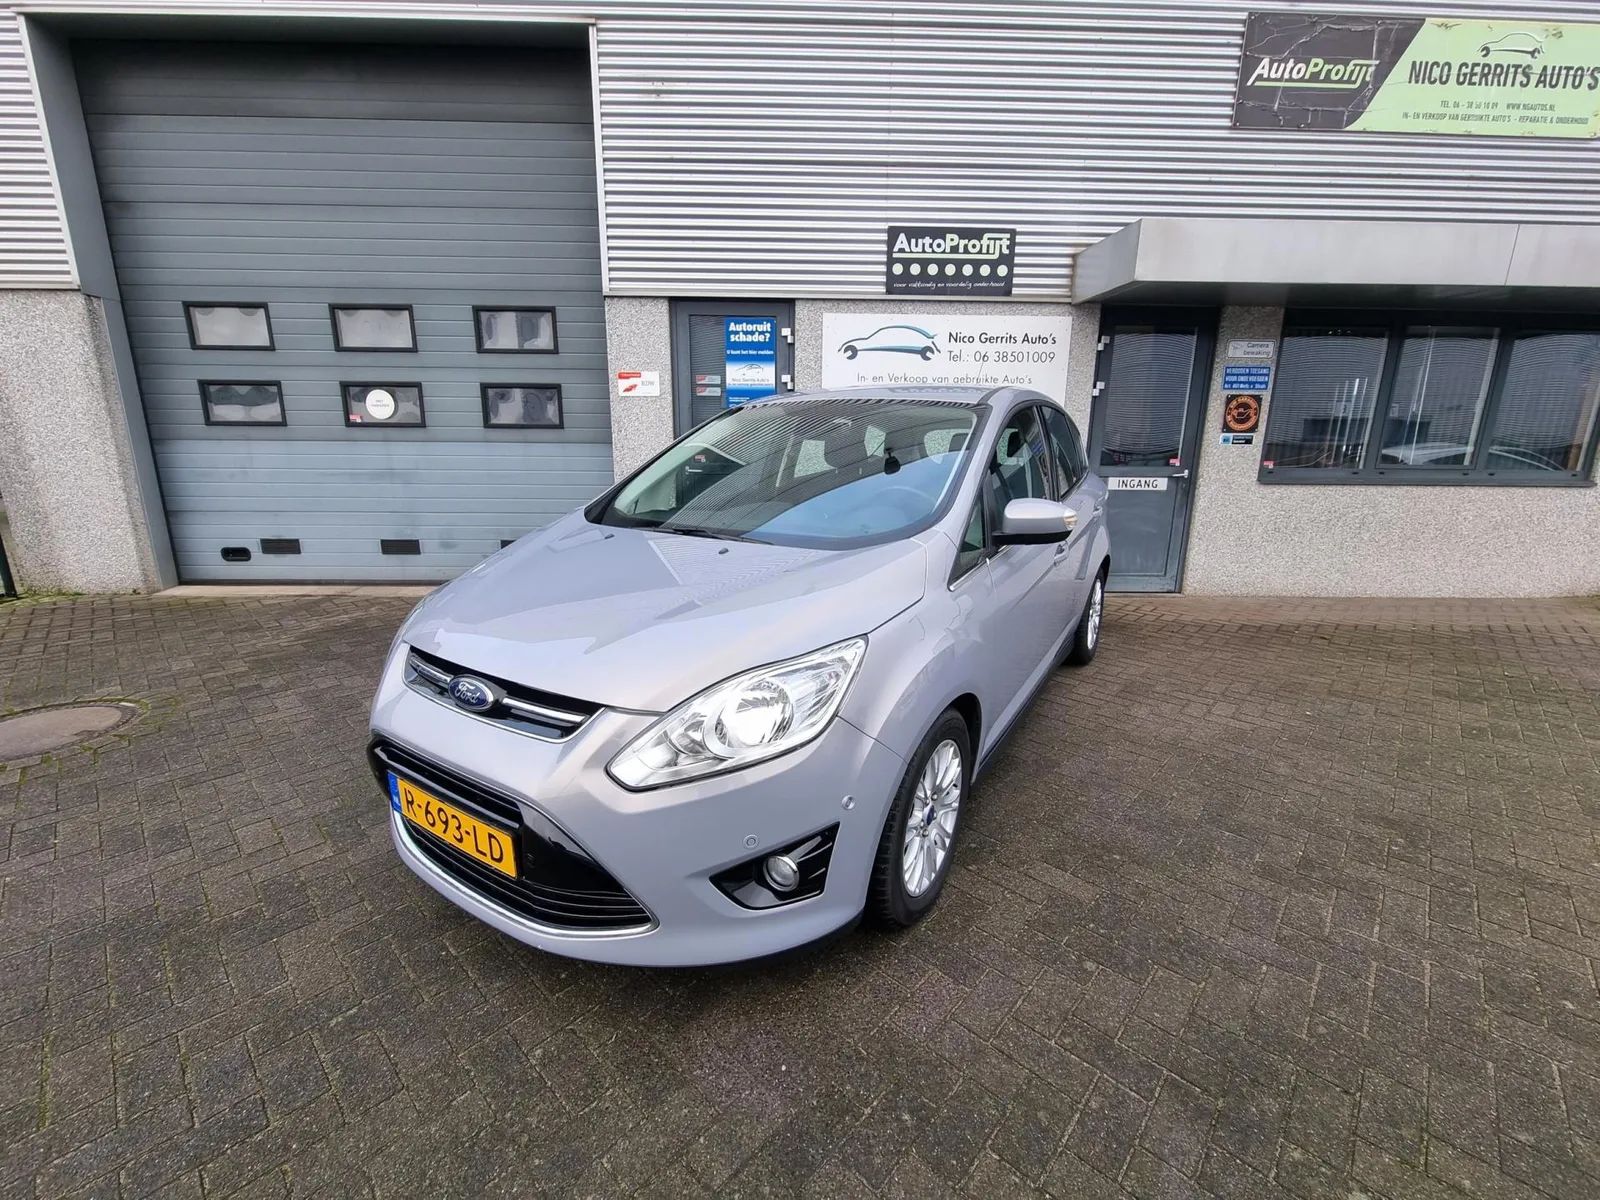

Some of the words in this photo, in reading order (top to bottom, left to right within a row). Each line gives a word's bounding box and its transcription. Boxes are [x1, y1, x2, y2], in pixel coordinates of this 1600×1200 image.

[1246, 57, 1380, 89] AutoProfijt
[1408, 60, 1452, 85] NICO
[1455, 62, 1534, 88] GERRITS
[1534, 64, 1600, 91] AUTO'S
[1412, 112, 1421, 120] EN
[1421, 113, 1447, 121] VERKOOP
[1448, 113, 1459, 121] VAN
[1491, 115, 1511, 123] AUTO'S
[1518, 116, 1548, 124] REPARATIE
[1555, 116, 1589, 125] ONDERHOUD
[892, 233, 1011, 259] AutoProfijt
[908, 280, 936, 290] vakkundig
[946, 281, 972, 290] voordelig
[728, 322, 771, 332] Autoruit
[730, 332, 770, 342] schade?
[948, 332, 975, 344] Nico
[978, 332, 1018, 345] Gerrits
[1021, 333, 1057, 345] Auto's
[947, 350, 970, 363] Tel.:
[973, 351, 990, 363] 06
[993, 351, 1056, 363] 38501009
[1243, 350, 1271, 358] bewaking
[857, 373, 869, 383] In-
[872, 375, 884, 383] en
[887, 373, 927, 384] Verkoop
[932, 376, 950, 384] van
[952, 374, 999, 385] gebruikte
[1002, 374, 1032, 385] Auto's
[1117, 478, 1159, 489] INGANG
[454, 681, 481, 704] Ford
[404, 787, 504, 864] R-693-LD
